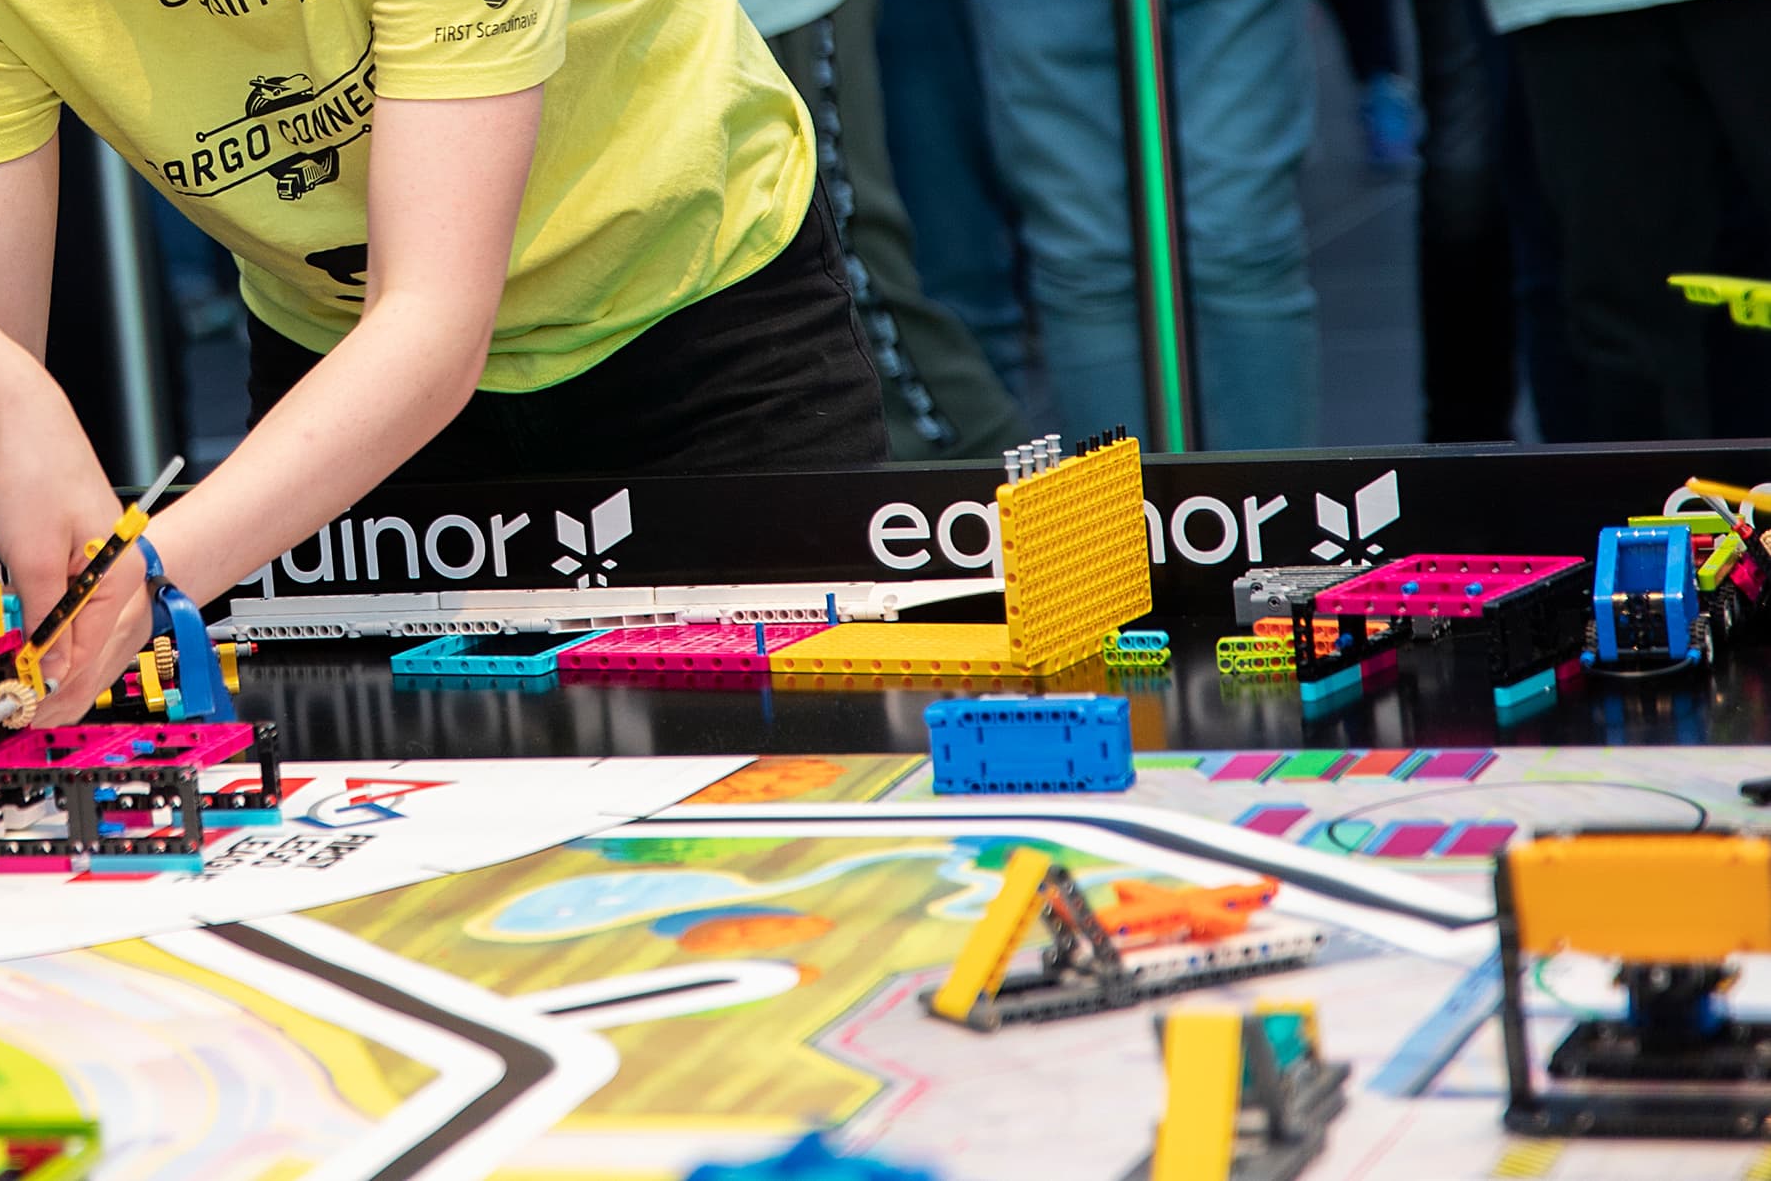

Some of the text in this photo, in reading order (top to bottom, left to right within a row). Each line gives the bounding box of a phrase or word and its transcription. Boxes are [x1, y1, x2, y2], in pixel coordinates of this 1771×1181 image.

[434, 9, 538, 43] FIRST Scandinavia
[278, 63, 377, 146] CONNEC
[236, 512, 530, 600] uinor
[869, 495, 1289, 579] eqor
